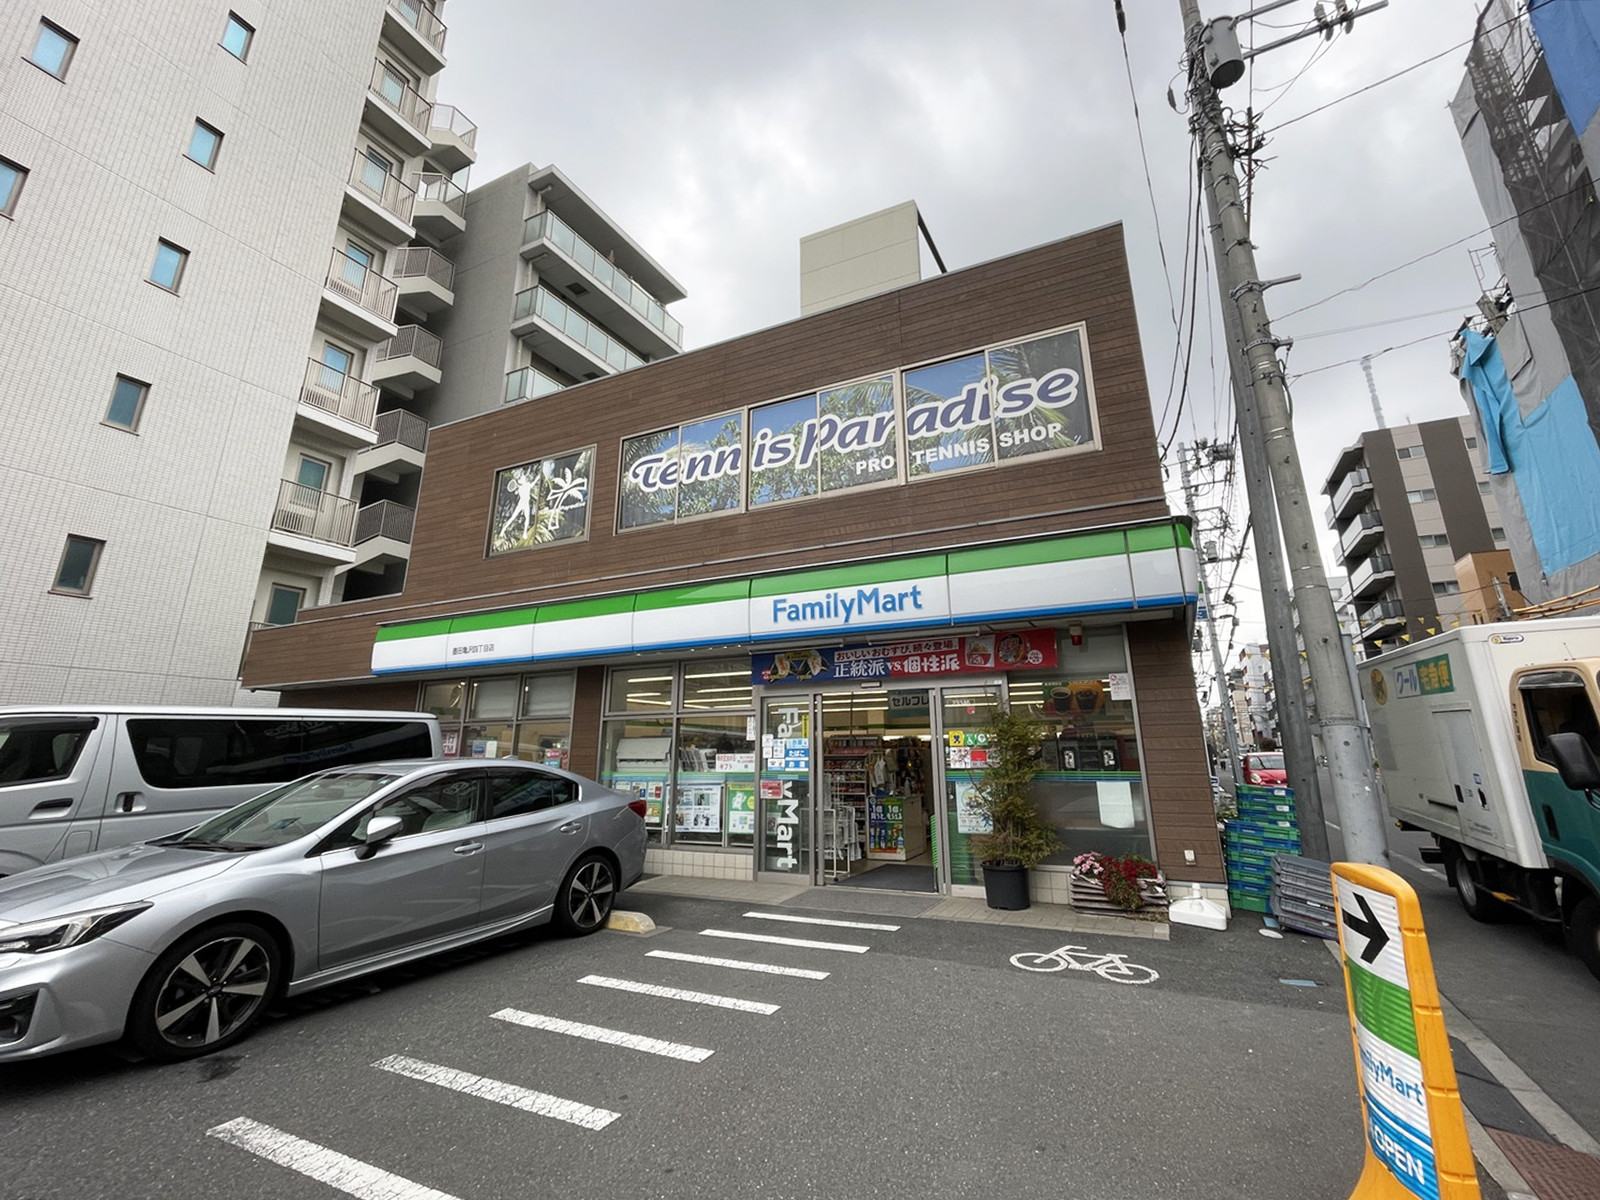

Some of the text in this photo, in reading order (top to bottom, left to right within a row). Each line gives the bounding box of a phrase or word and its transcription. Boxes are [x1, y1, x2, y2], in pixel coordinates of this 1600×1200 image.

[629, 367, 1080, 493] Tennis Paradise
[856, 422, 1062, 475] PRO TENNIS SHOP
[772, 585, 923, 624] FamilyMart
[788, 749, 806, 758] たばこ
[1374, 1124, 1426, 1186] OPEN
